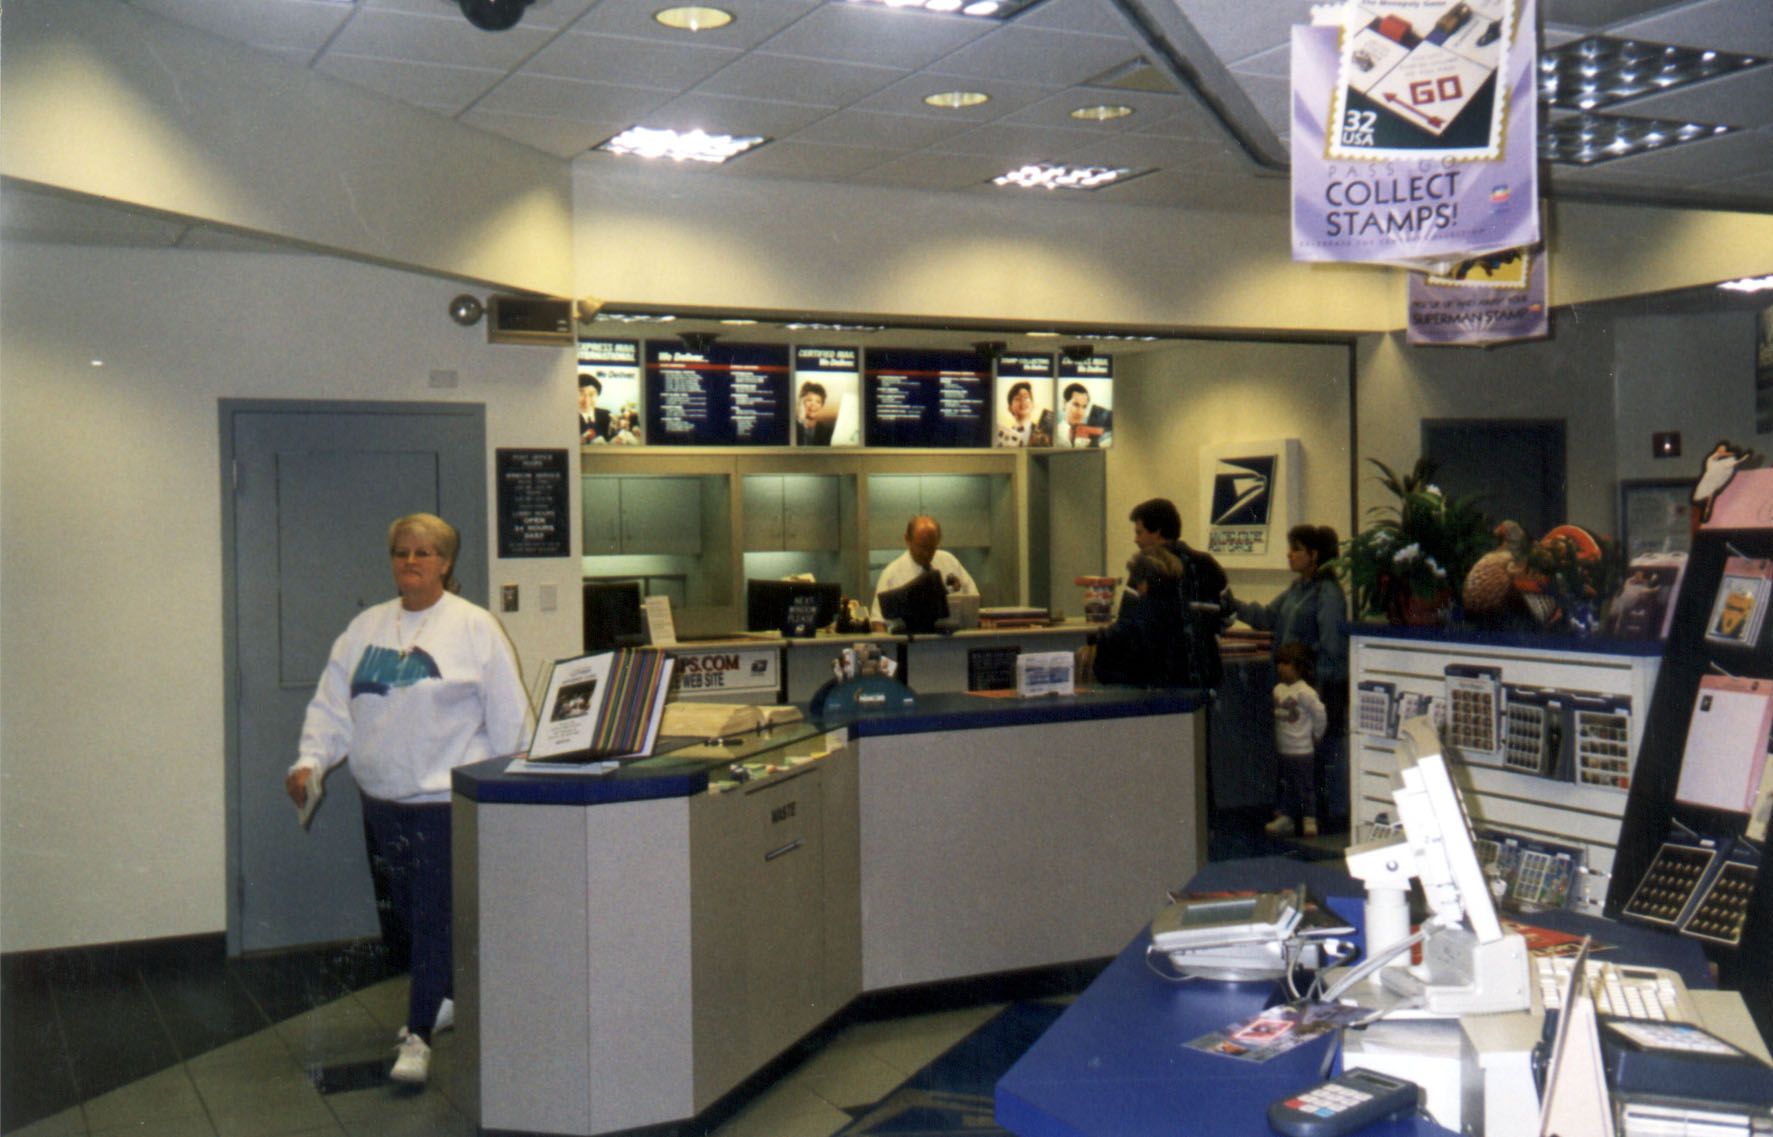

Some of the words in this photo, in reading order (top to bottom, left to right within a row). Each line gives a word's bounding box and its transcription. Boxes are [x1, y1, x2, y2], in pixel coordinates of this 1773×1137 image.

[1409, 75, 1463, 105] GO
[1345, 110, 1378, 133] 32
[1342, 131, 1374, 146] USA
[1329, 162, 1395, 178] PASS
[1419, 156, 1457, 173] GO
[1326, 171, 1461, 207] COLLECT
[1326, 202, 1458, 237] STAMPS!
[1413, 310, 1483, 325] SUPERMAN
[658, 352, 673, 361] We
[683, 673, 702, 688] WEB
[704, 671, 725, 687] SITE
[771, 800, 797, 824] WASTE
